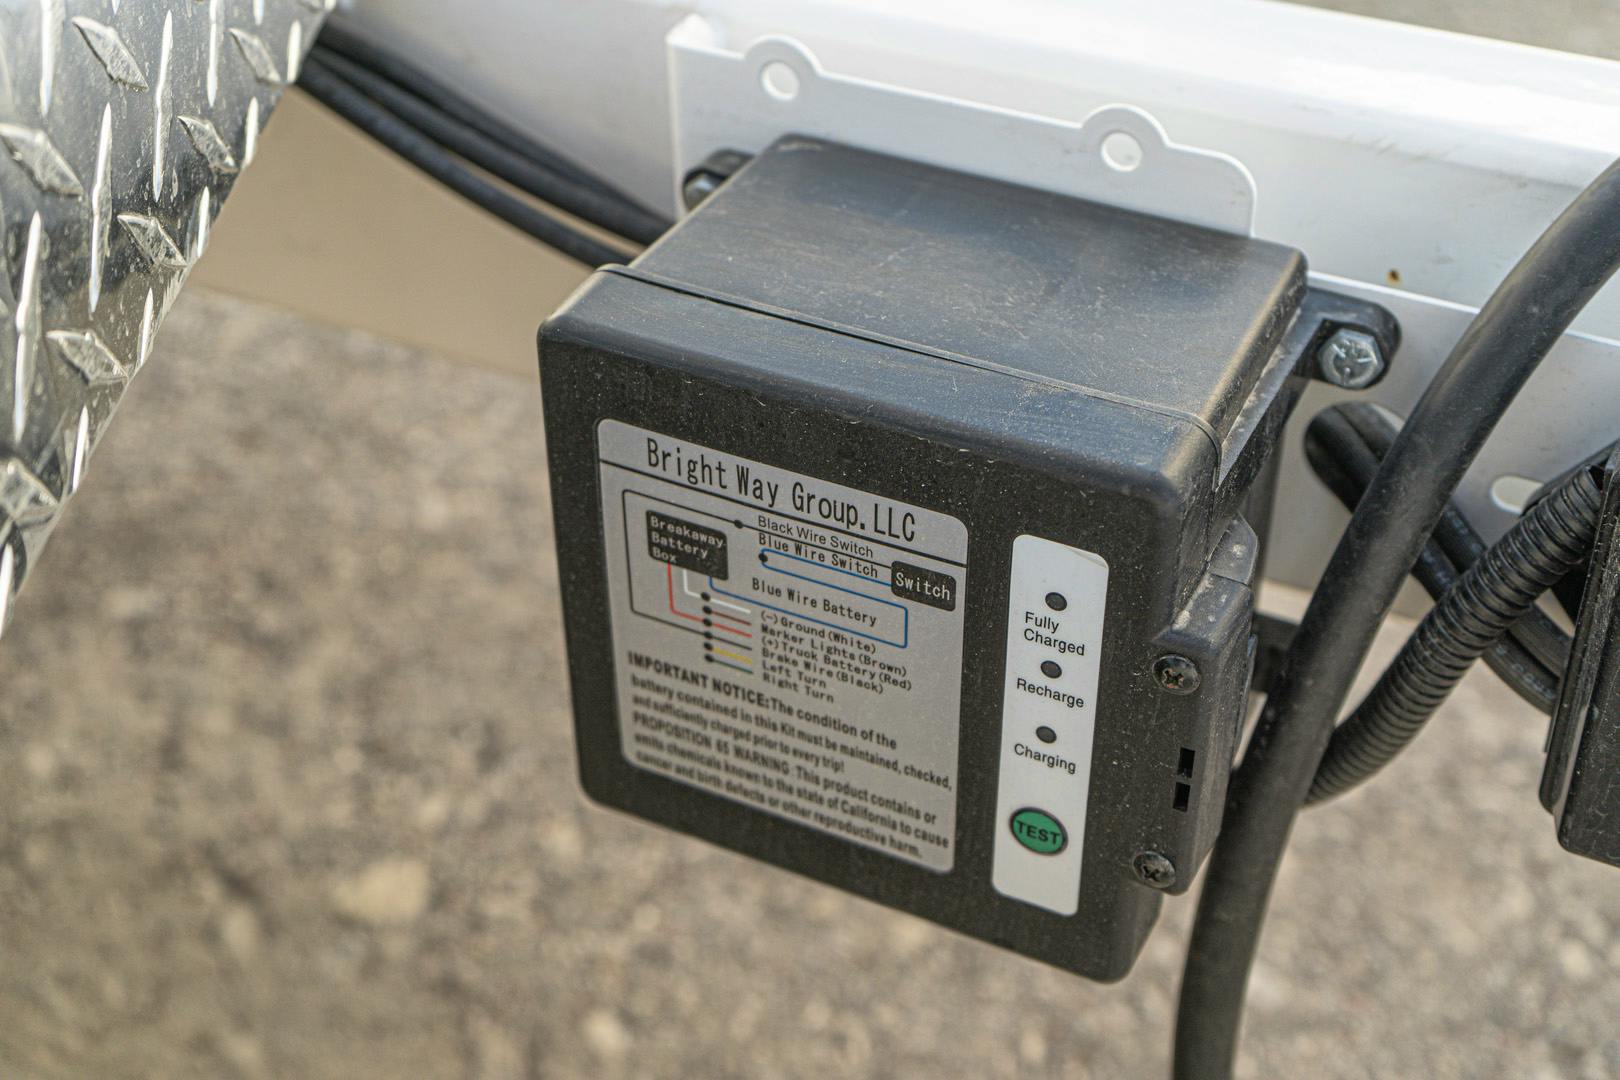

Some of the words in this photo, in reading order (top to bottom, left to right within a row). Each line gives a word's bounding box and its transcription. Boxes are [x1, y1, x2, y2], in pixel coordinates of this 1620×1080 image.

[647, 438, 727, 489] Bright
[736, 465, 778, 508] Way
[651, 516, 725, 548] Breakaway
[652, 532, 708, 559] Battery
[758, 515, 793, 536] Black
[797, 526, 826, 544] Wire
[830, 536, 873, 558] Switch
[653, 547, 676, 563] Box
[759, 533, 788, 552] Blue
[795, 542, 825, 562] Wire
[832, 554, 879, 578] Switch
[896, 572, 950, 600] Switch
[752, 577, 781, 597] Blue
[787, 588, 817, 608] Wire
[823, 599, 876, 627] Battery
[761, 623, 804, 644] Marker
[1025, 611, 1059, 634] Fully
[762, 647, 798, 667] Brake
[1024, 628, 1085, 656] Charged
[762, 660, 791, 677] Left
[798, 671, 826, 688] Turn
[763, 672, 798, 692] Right
[805, 685, 834, 703] Turn
[629, 652, 707, 688] IMPORTANT
[797, 709, 857, 736] condition
[860, 729, 874, 741] of
[876, 733, 896, 750] the
[1016, 677, 1084, 708] Recharge
[631, 674, 674, 700] battery
[676, 691, 737, 719] contained
[740, 709, 752, 723] in
[755, 715, 778, 732] this
[781, 723, 795, 736] Kit
[797, 730, 822, 746] must
[825, 737, 837, 751] be
[840, 744, 901, 774] maintained,
[904, 765, 951, 791] checked,
[753, 734, 778, 750] prior
[779, 742, 790, 754] to
[792, 748, 820, 767] every
[1014, 743, 1076, 775] Charging
[796, 765, 820, 785] This
[823, 778, 868, 802] product
[870, 794, 921, 820] contains
[924, 812, 936, 824] or
[827, 797, 839, 810] of
[841, 800, 897, 831] California
[900, 821, 912, 835] to
[914, 829, 948, 848] cause
[1016, 819, 1060, 845] TEST
